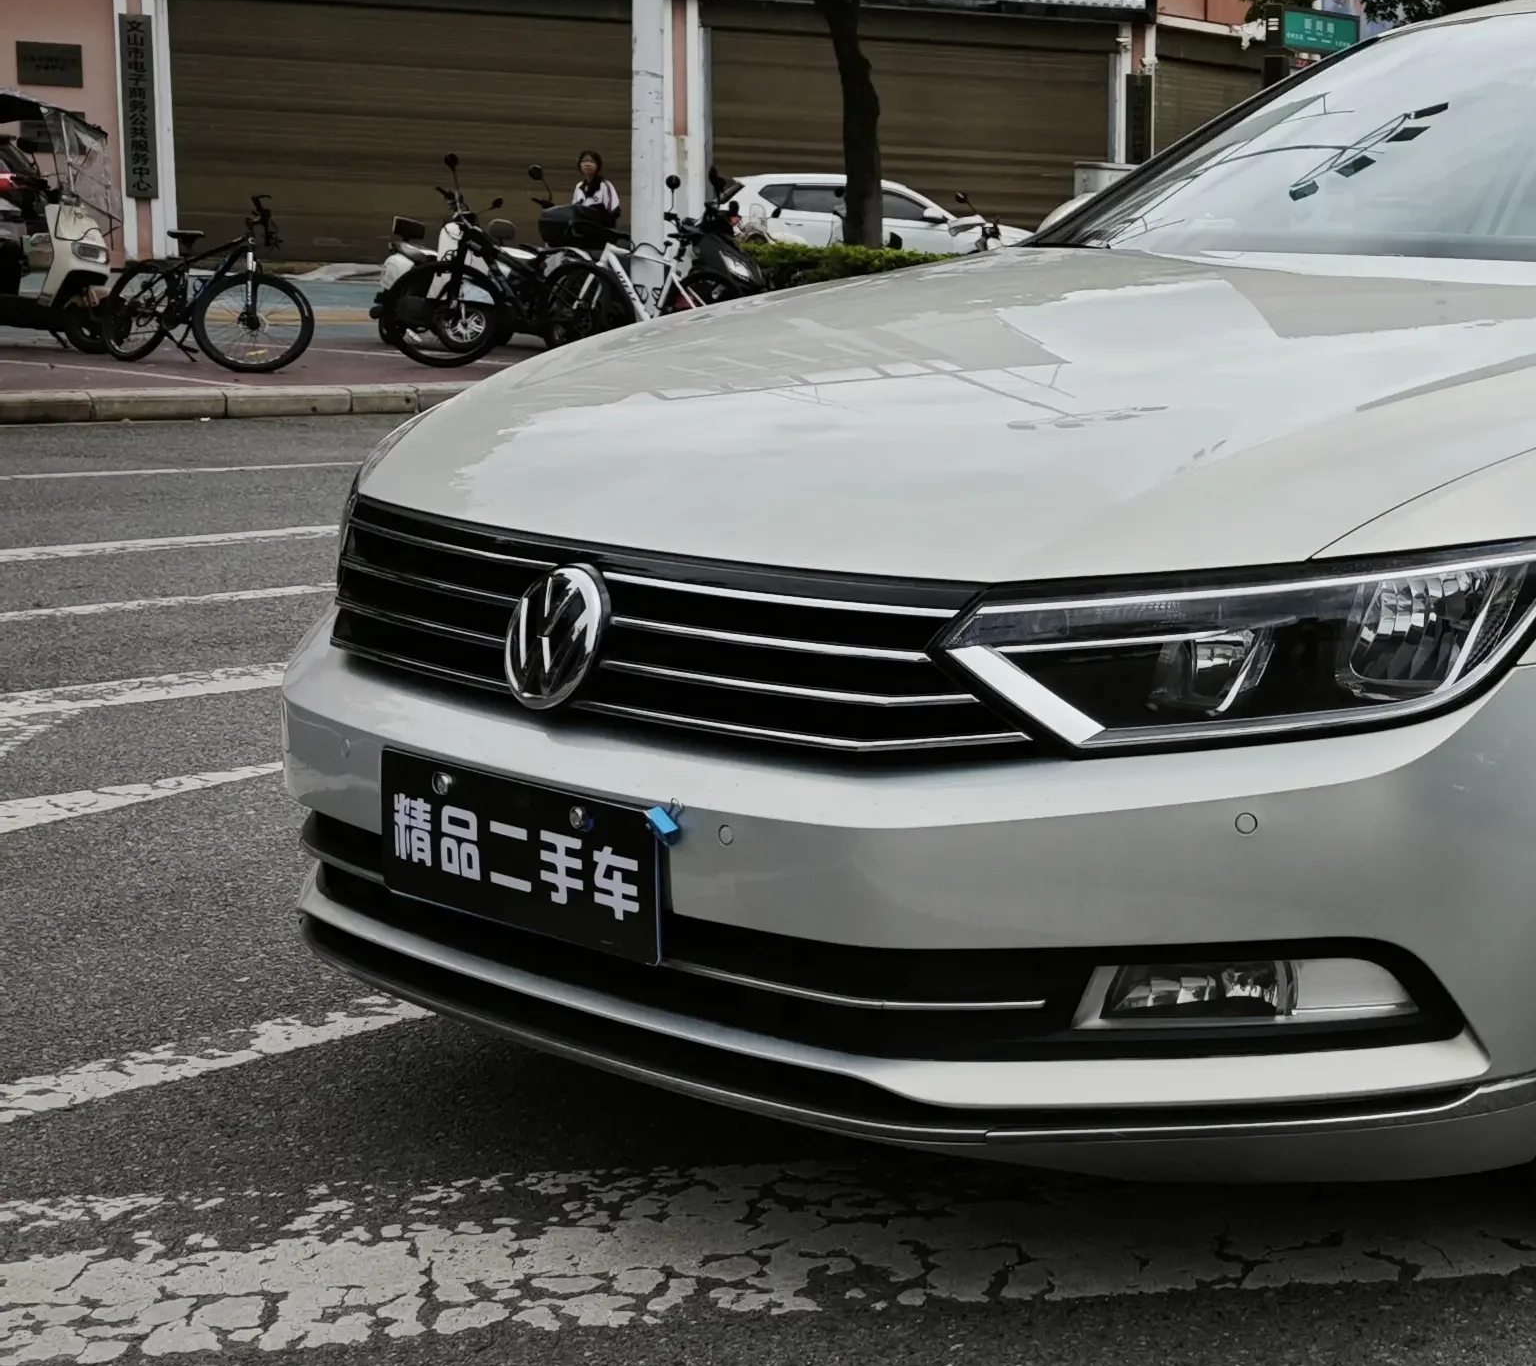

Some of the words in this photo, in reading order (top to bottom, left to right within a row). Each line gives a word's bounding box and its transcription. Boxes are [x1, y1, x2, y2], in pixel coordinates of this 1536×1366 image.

[126, 19, 152, 192] 文山市电子商务公共服务中心
[393, 793, 640, 921] 精品二手车
